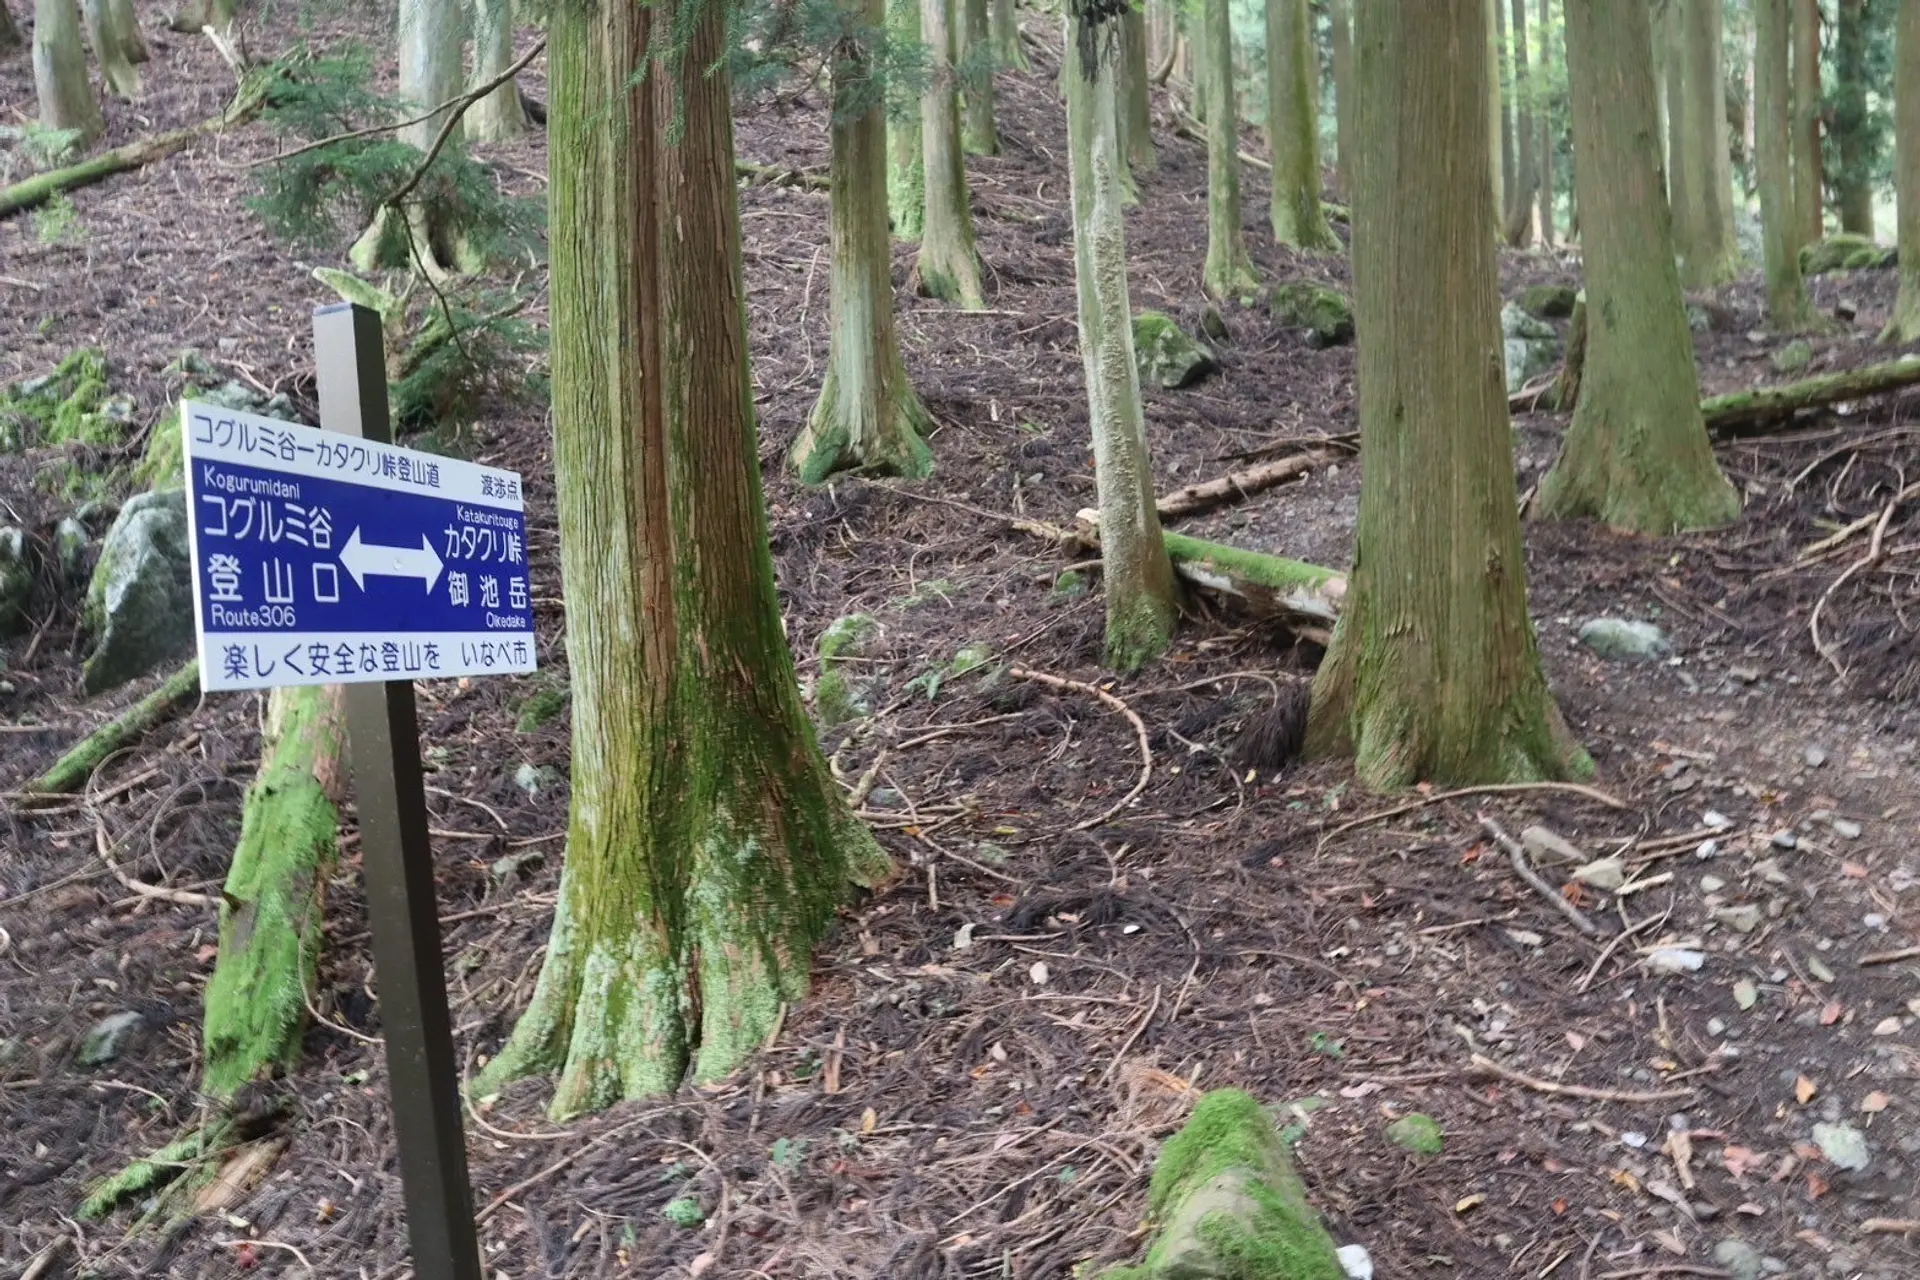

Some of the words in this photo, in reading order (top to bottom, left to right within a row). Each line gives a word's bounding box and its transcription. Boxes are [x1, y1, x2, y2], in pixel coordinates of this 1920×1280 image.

[203, 464, 301, 499] Kogurumidani
[480, 473, 519, 501] 渡渉点
[202, 494, 333, 549] コグルミ谷
[456, 504, 519, 531] Katakuritouge
[444, 523, 523, 566] カタクリ峠
[207, 553, 340, 604] 登山口
[447, 569, 527, 609] 御池岳
[210, 603, 297, 627] Route306
[485, 611, 526, 629] Oikedake
[223, 640, 441, 680] 楽しく安全な登山を
[461, 639, 528, 668] いなべ市
